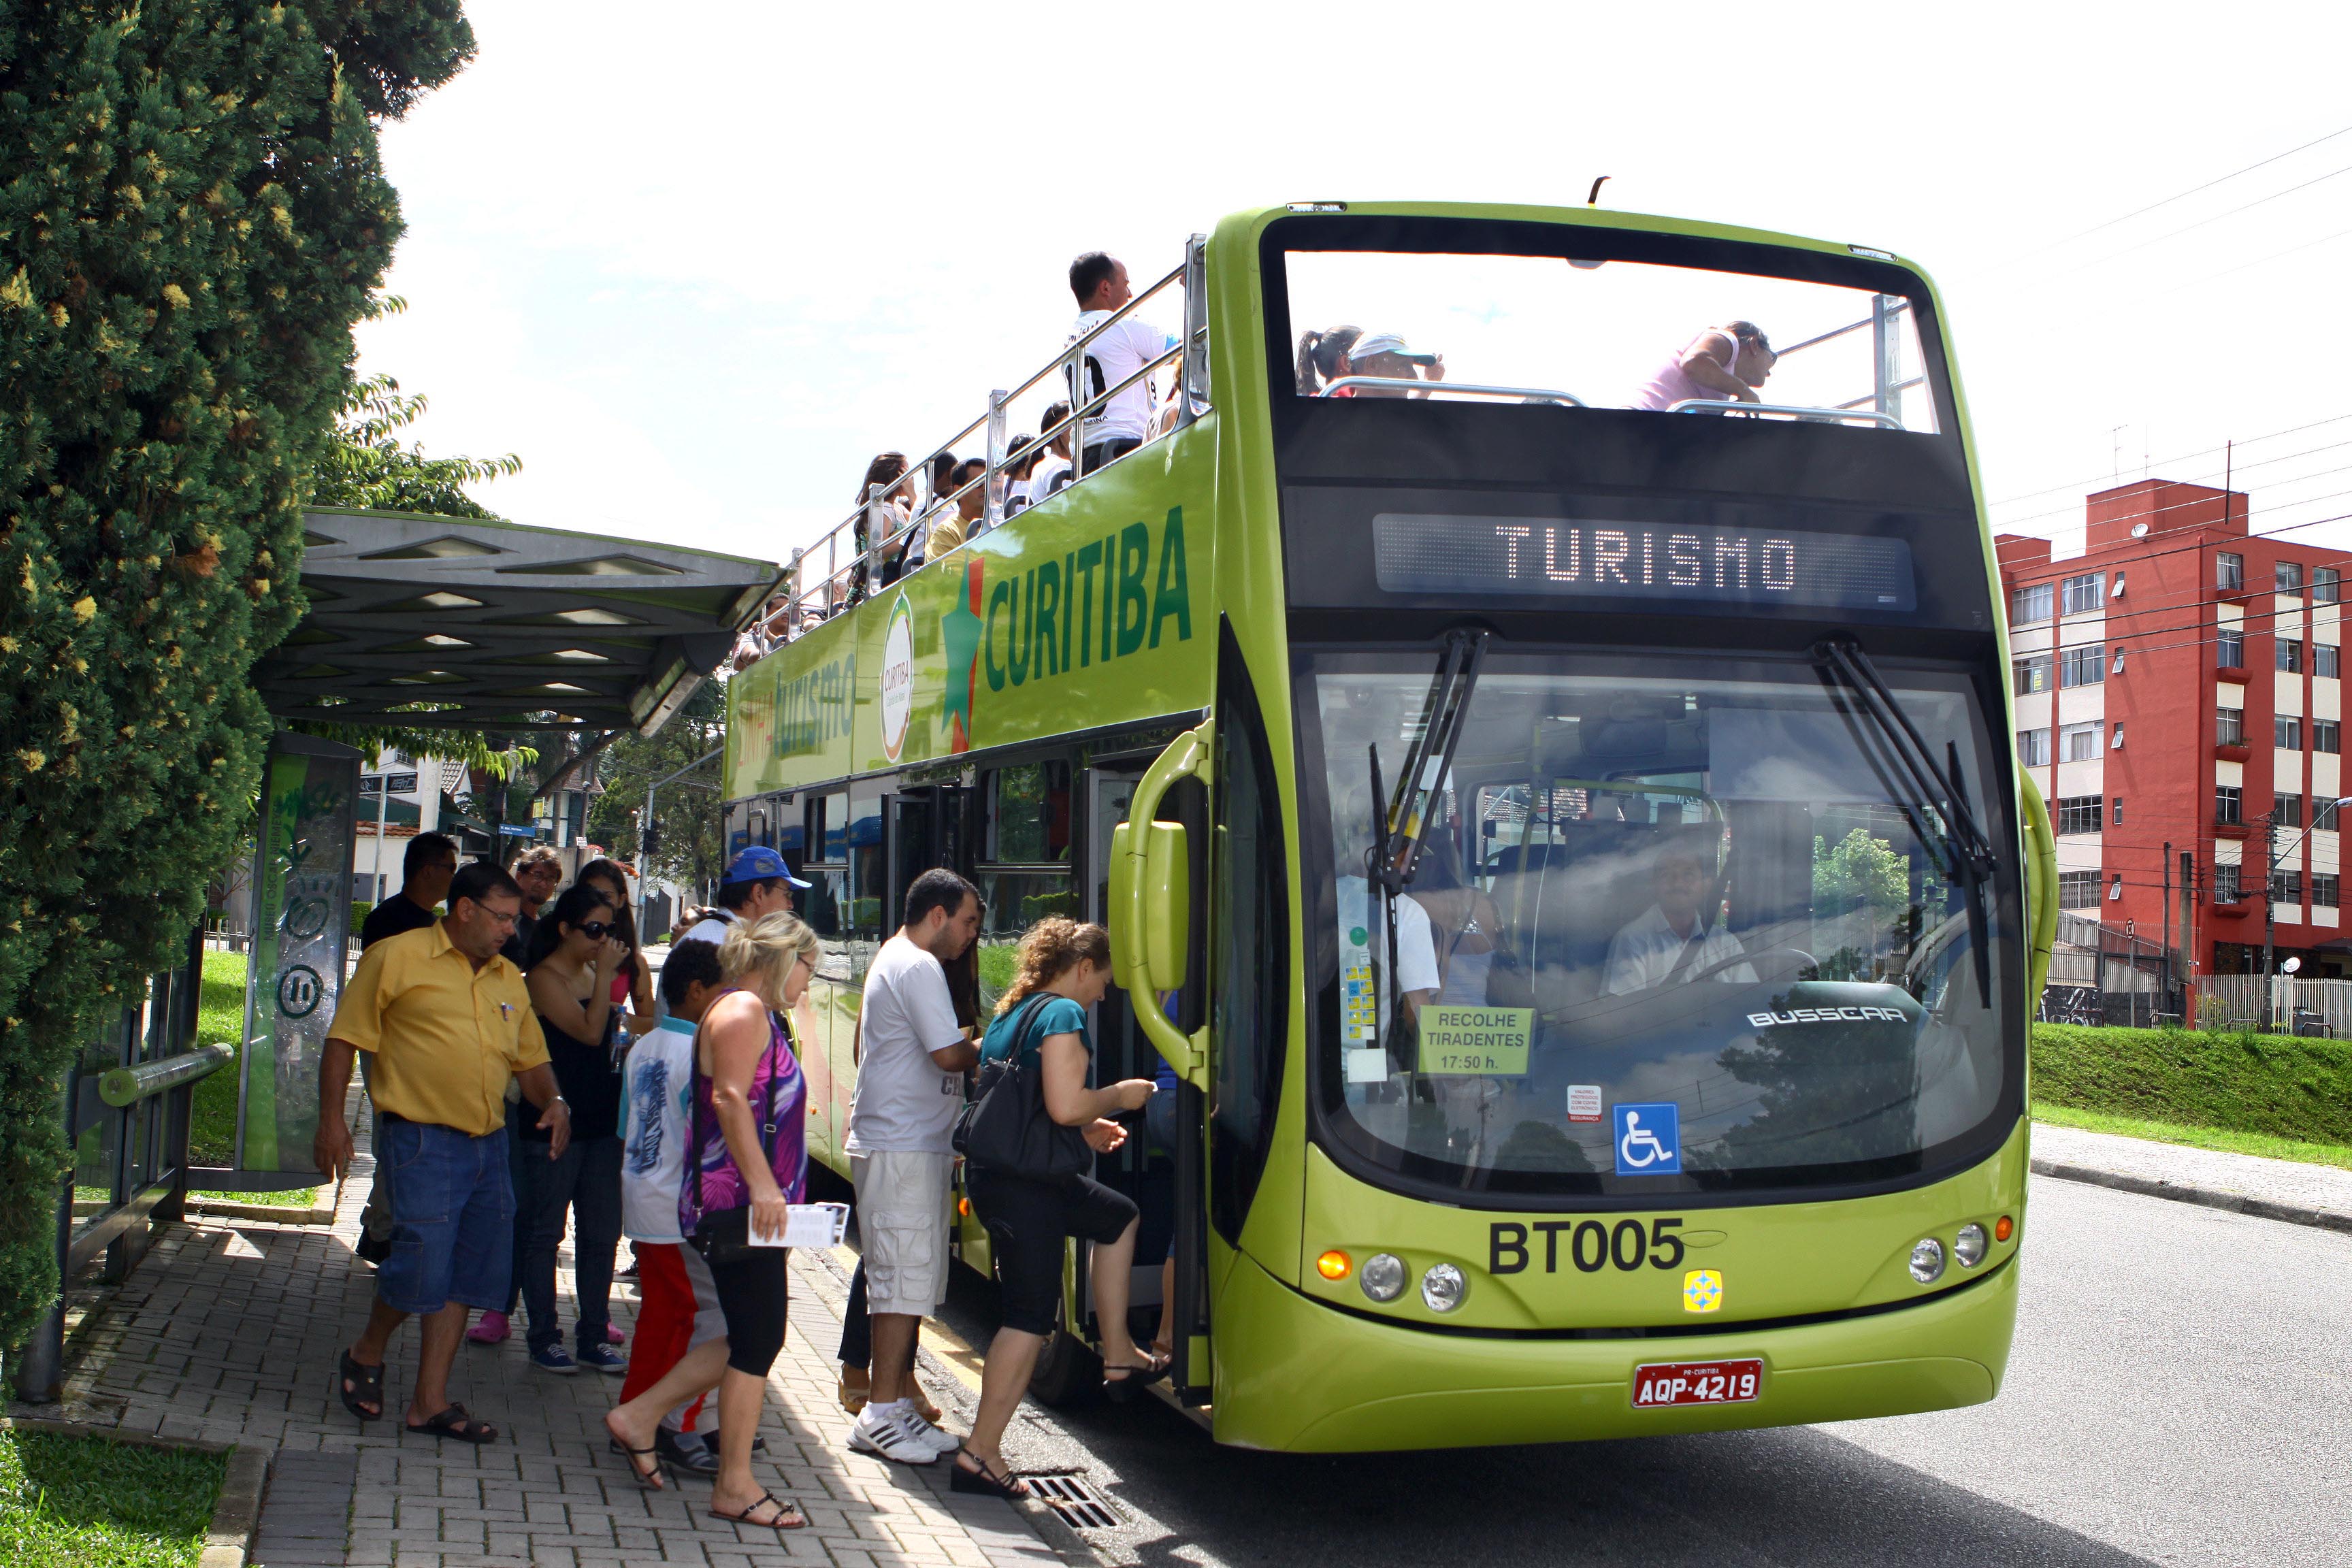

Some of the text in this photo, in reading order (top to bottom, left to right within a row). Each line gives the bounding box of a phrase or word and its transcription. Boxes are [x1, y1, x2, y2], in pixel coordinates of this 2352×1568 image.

[1495, 525, 1795, 591] TURISMO
[985, 505, 1192, 692] CURITIBA
[885, 660, 909, 691] CURITIBA
[774, 653, 855, 759] turismo
[1439, 1013, 1516, 1027] RECOLHE
[1746, 1006, 1908, 1027] BUSSCAR
[1427, 1032, 1524, 1047] TIRADENTES
[1441, 1056, 1499, 1068] 17:50 h.
[1489, 1218, 1686, 1275] BT005
